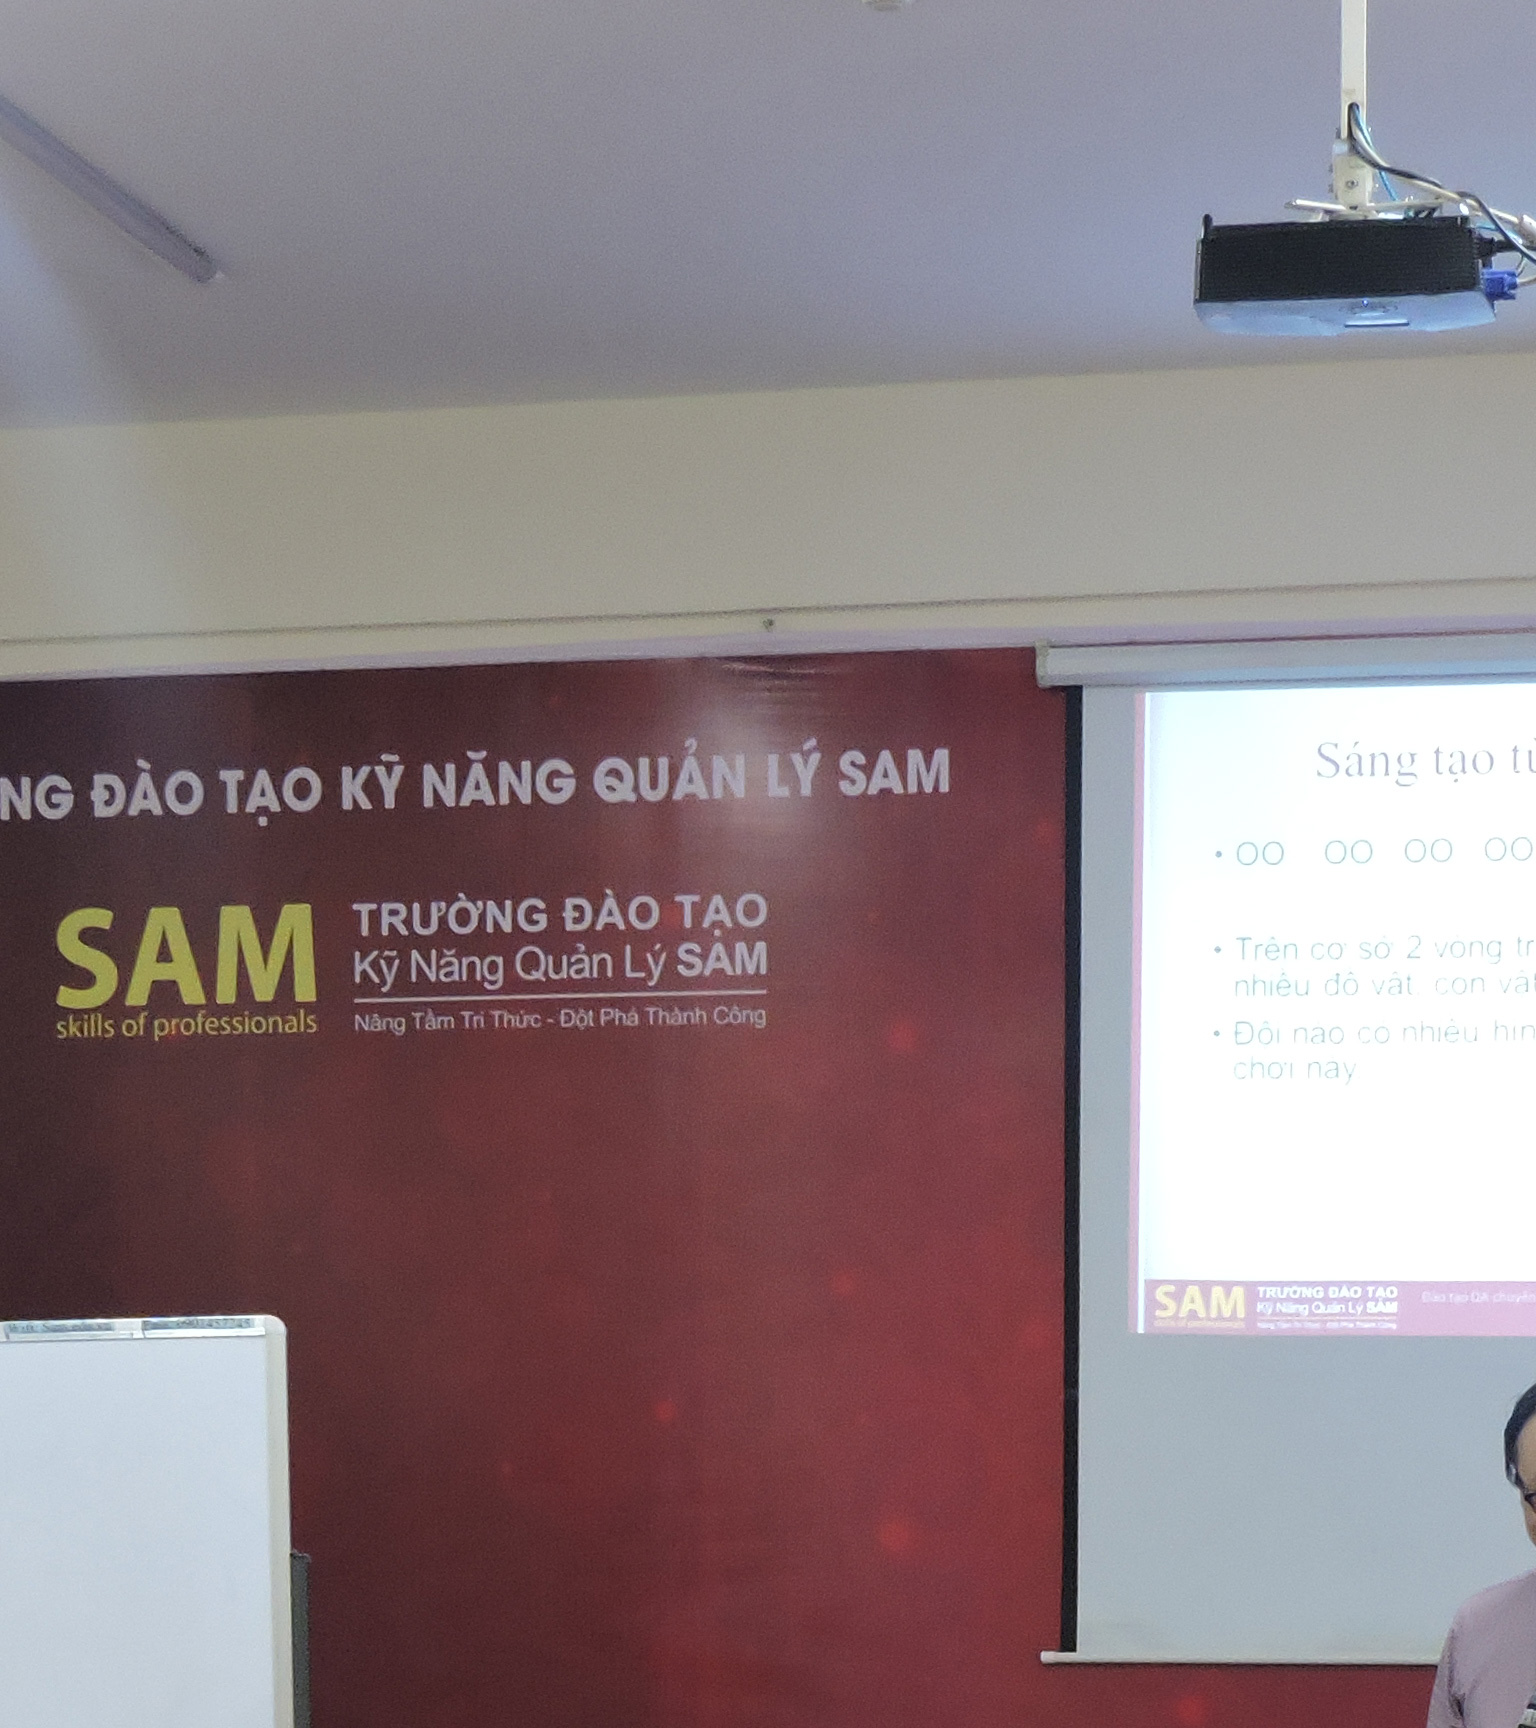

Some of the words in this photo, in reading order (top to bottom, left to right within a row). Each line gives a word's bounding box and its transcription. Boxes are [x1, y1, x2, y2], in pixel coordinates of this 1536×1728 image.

[90, 758, 205, 819] ĐÀO
[219, 766, 322, 827] TẠO
[341, 753, 405, 811] KỸ
[422, 749, 577, 808] NĂNG
[592, 738, 746, 804] QUẢN
[765, 737, 823, 800] LÝ
[838, 748, 950, 797] SAM
[1316, 740, 1419, 787] Sáng
[1433, 745, 1495, 783] tạo
[352, 892, 548, 937] TRƯỜNG
[562, 889, 660, 931] ĐÀO
[674, 892, 767, 937] TẠO
[55, 903, 317, 1010] SAM
[353, 949, 400, 993] Kỹ
[409, 947, 504, 991] Năng
[514, 943, 613, 982] Quản
[624, 942, 667, 986] Lý
[677, 941, 767, 977] SAM
[1235, 936, 1299, 961] Trên
[1407, 934, 1422, 959] 2
[1435, 976, 1486, 995] con
[56, 1013, 115, 1039] skills
[121, 1011, 148, 1038] of
[153, 1009, 318, 1041] professionals
[354, 1012, 406, 1036] Nâng
[713, 1004, 767, 1028] Công
[1154, 1284, 1246, 1319] SAM
